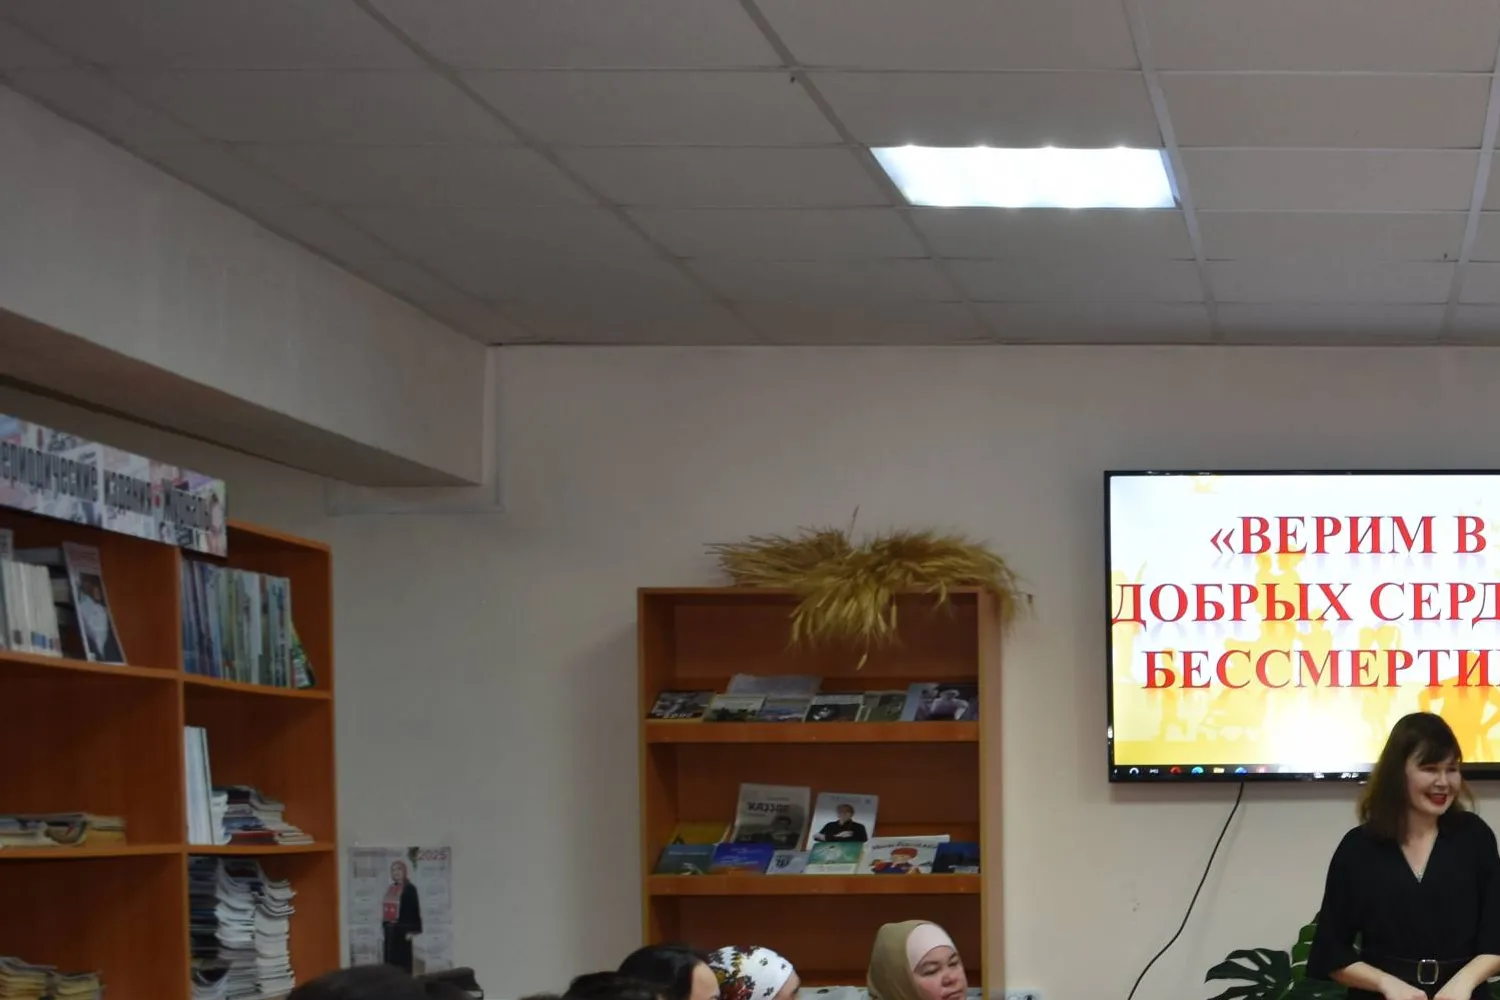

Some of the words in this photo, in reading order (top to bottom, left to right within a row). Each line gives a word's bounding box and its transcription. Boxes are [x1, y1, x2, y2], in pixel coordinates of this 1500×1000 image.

[1210, 515, 1437, 555] «ВЕРИМ
[1454, 515, 1487, 555] В
[1111, 582, 1352, 631] ДОБРЫХ
[417, 849, 449, 862] 2025
